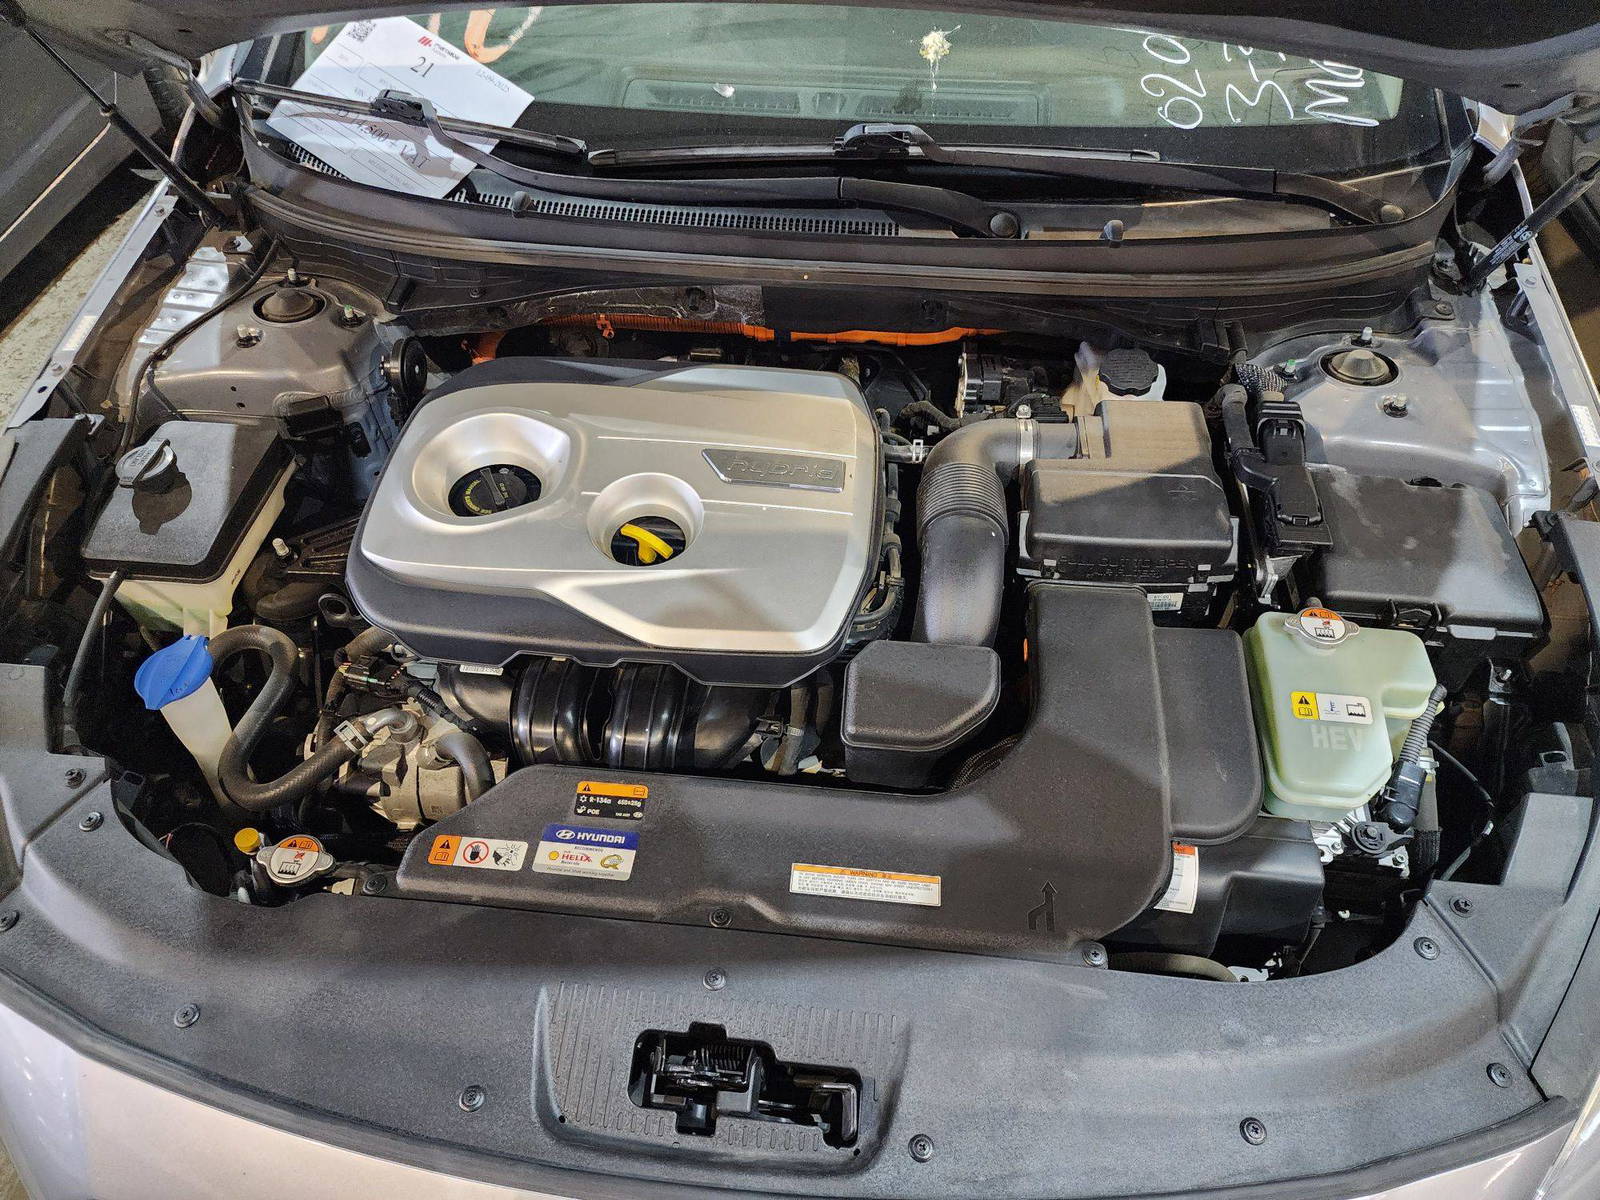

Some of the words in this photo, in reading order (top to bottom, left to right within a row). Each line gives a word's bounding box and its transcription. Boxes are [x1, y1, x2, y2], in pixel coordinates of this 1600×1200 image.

[410, 56, 435, 77] 21
[1140, 33, 1207, 130] 020
[1311, 724, 1363, 750] HEV
[576, 832, 626, 844] HYUNDAI
[561, 853, 592, 863] HELIX
[849, 870, 878, 878] WARNING
